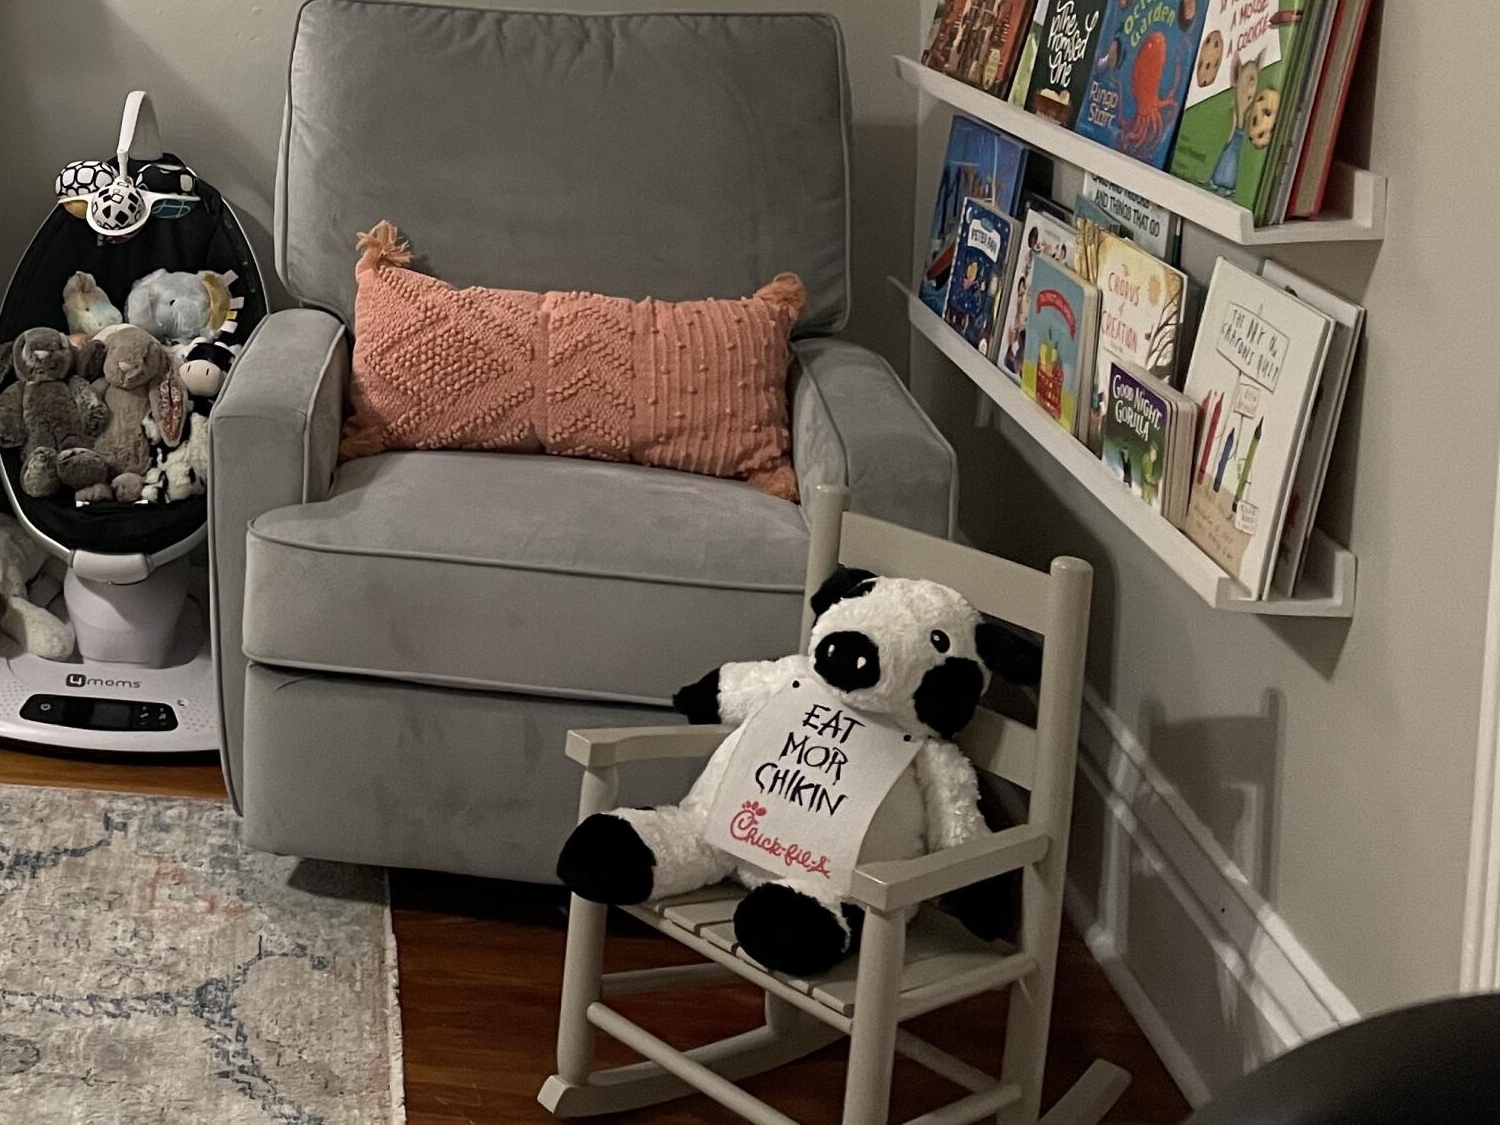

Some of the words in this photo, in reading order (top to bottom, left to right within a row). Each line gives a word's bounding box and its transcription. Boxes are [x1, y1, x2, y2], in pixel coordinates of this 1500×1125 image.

[1230, 10, 1238, 33] A
[1226, 39, 1233, 59] A
[1090, 81, 1119, 111] Ringo
[1087, 103, 1117, 129] Starr
[1149, 218, 1160, 238] GO
[66, 673, 142, 689] 4moms
[802, 703, 866, 745] EAT
[778, 731, 849, 786] MOR
[755, 762, 849, 816] CHIKIN
[729, 804, 831, 879] Chick-fil-A
